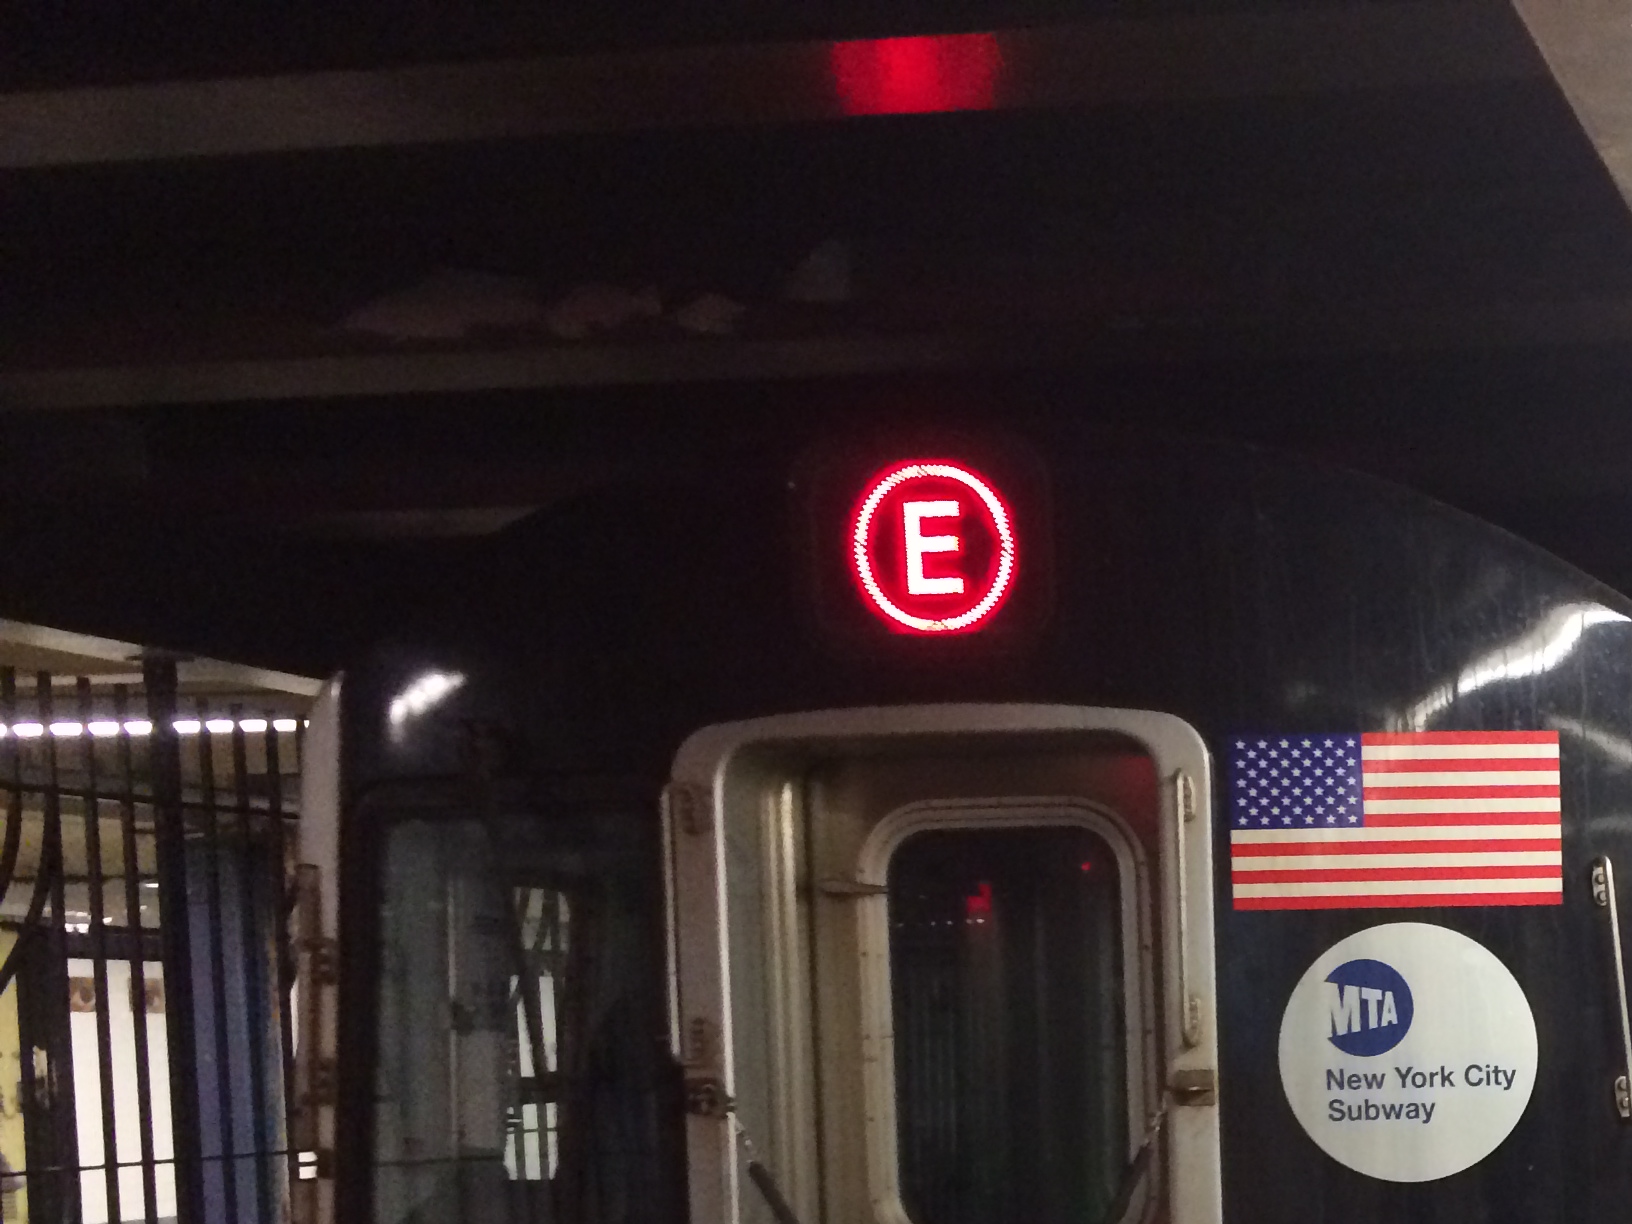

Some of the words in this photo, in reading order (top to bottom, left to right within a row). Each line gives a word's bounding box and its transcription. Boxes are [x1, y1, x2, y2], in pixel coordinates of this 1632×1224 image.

[903, 500, 964, 595] E
[1324, 981, 1398, 1036] MTA
[1326, 1067, 1386, 1090] New
[1394, 1065, 1455, 1089] York
[1464, 1064, 1516, 1090] City
[1328, 1099, 1435, 1123] Subway
